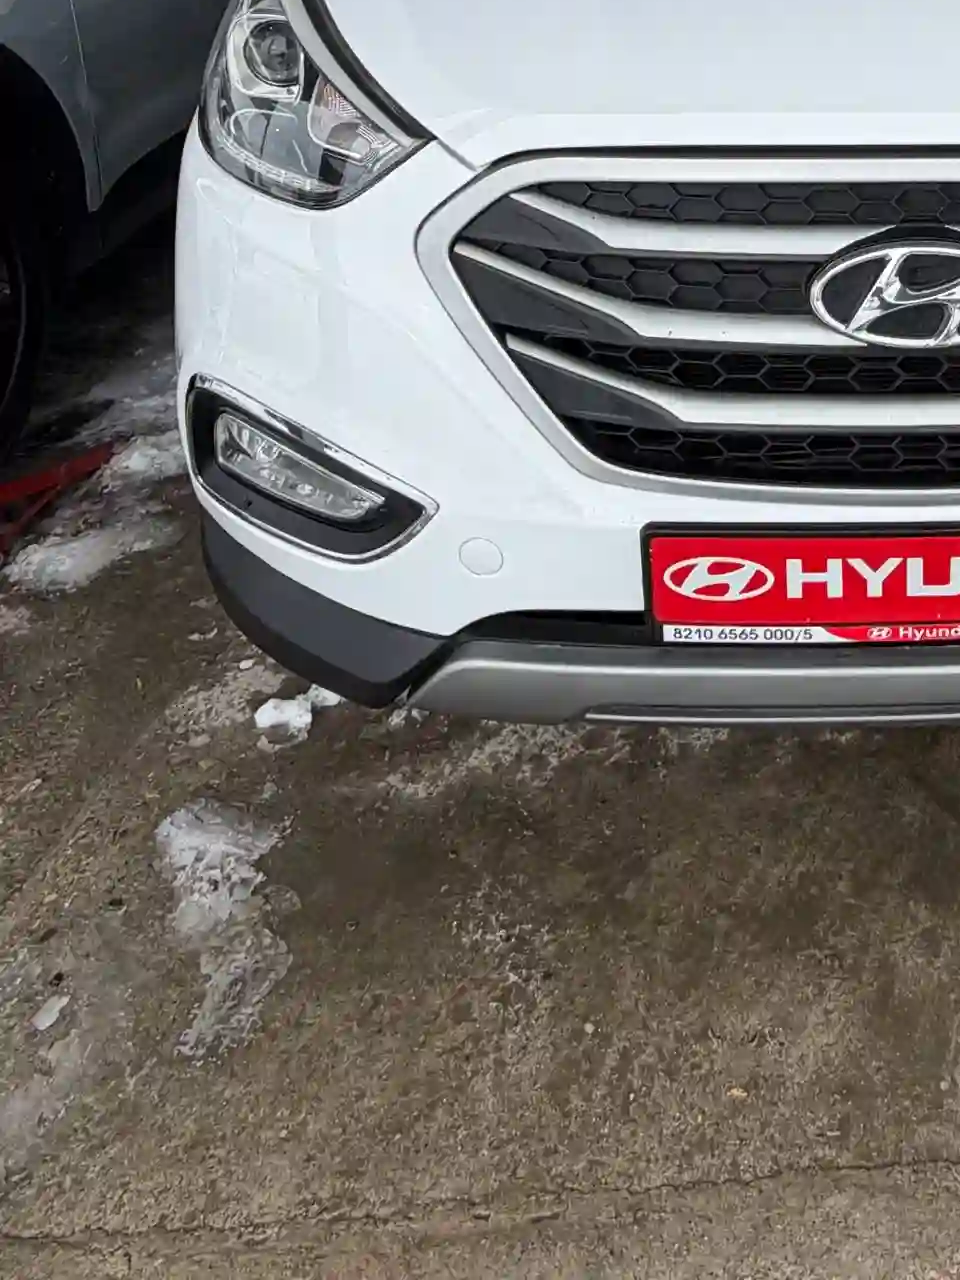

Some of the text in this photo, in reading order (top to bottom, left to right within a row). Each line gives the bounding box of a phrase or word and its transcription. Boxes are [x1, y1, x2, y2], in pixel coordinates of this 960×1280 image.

[673, 627, 813, 643] 8210 6565 000/5
